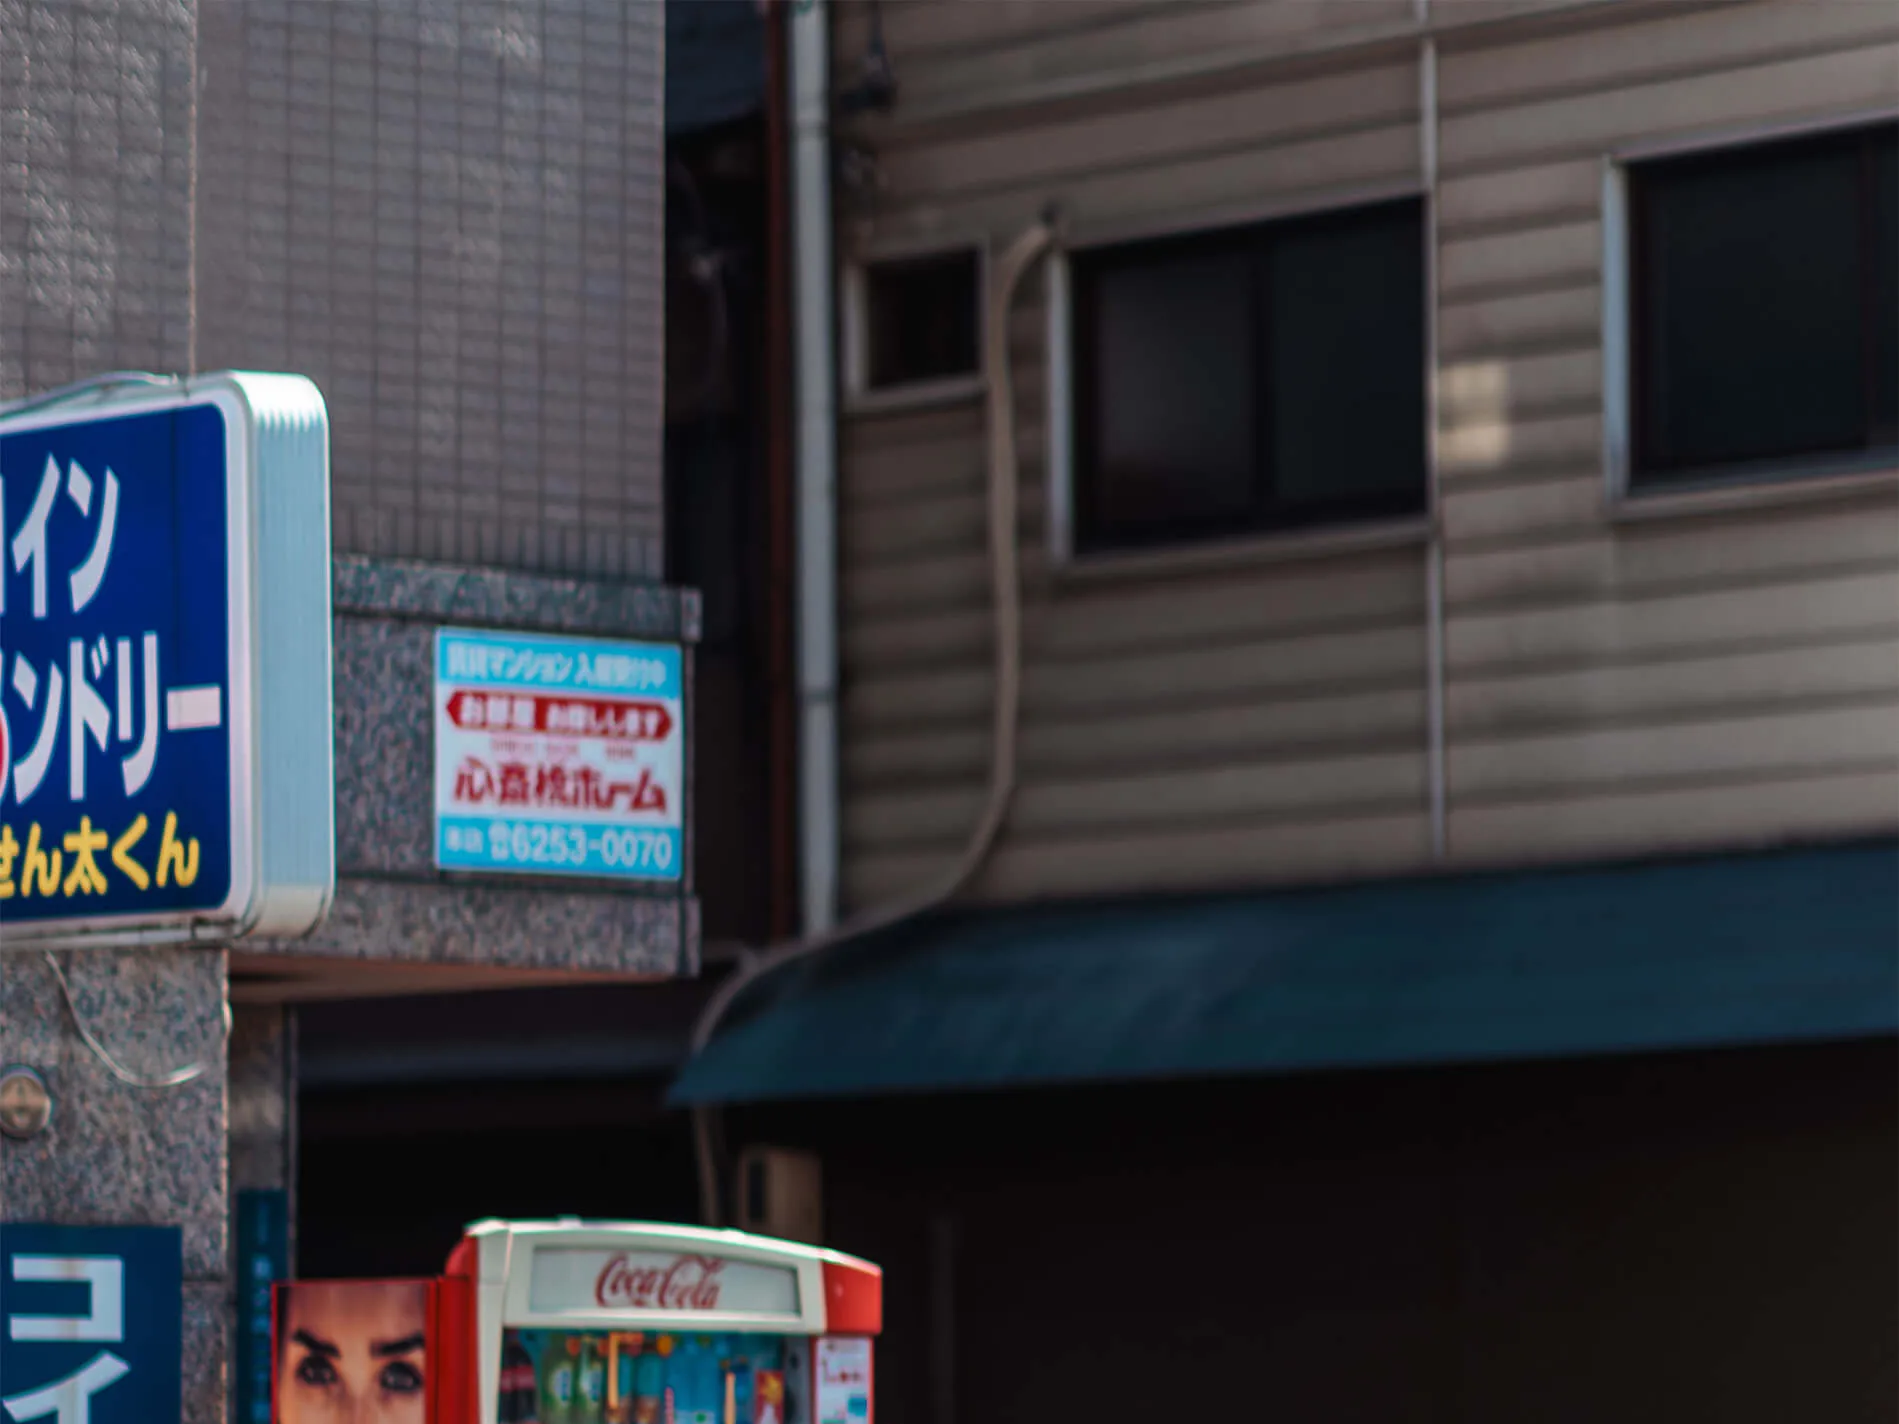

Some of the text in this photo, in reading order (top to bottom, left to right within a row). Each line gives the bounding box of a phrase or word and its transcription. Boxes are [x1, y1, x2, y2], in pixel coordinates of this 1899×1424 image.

[0, 452, 119, 619] イン
[0, 631, 220, 805] ンドリー
